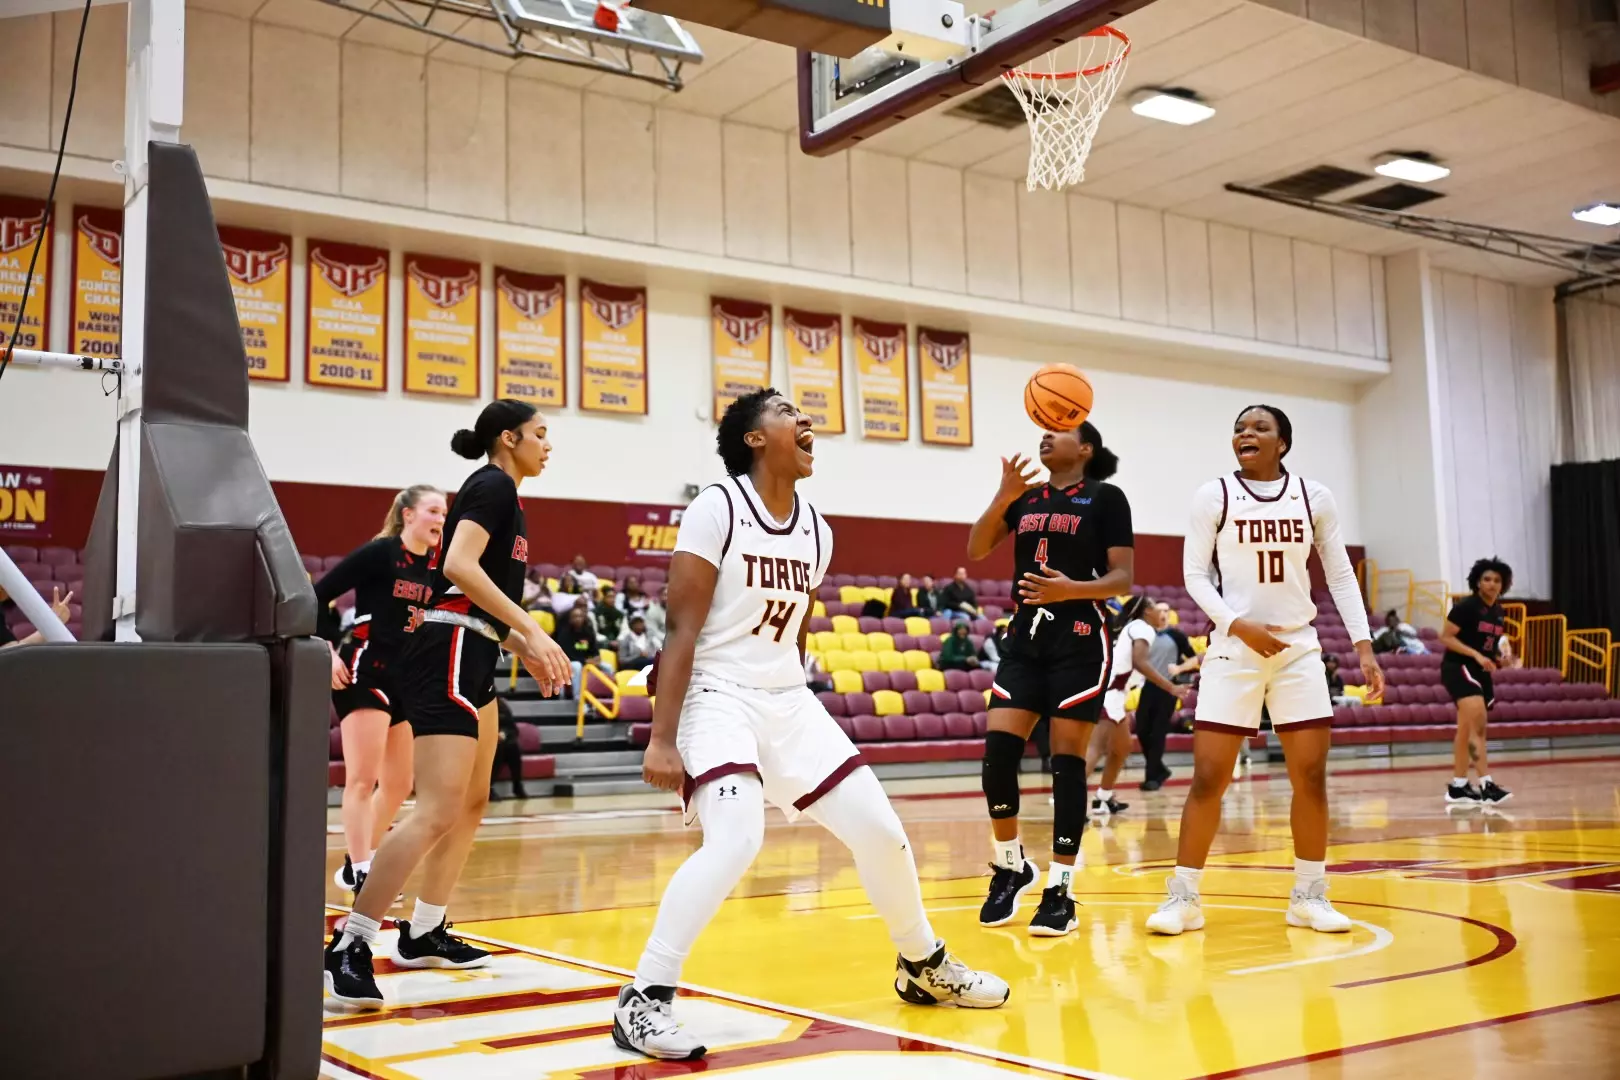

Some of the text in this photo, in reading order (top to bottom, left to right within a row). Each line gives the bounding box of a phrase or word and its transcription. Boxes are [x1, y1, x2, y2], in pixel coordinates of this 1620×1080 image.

[78, 320, 120, 333] BASKE
[312, 346, 381, 362] BASKETBALL
[319, 363, 373, 381] 2010-11
[426, 373, 458, 388] 2012
[1017, 513, 1082, 535] EAST BAY
[1233, 519, 1304, 543] TOROS
[1035, 537, 1048, 570] 4
[741, 553, 810, 596] TOROS
[1256, 550, 1284, 583] 10
[751, 599, 797, 643] 14
